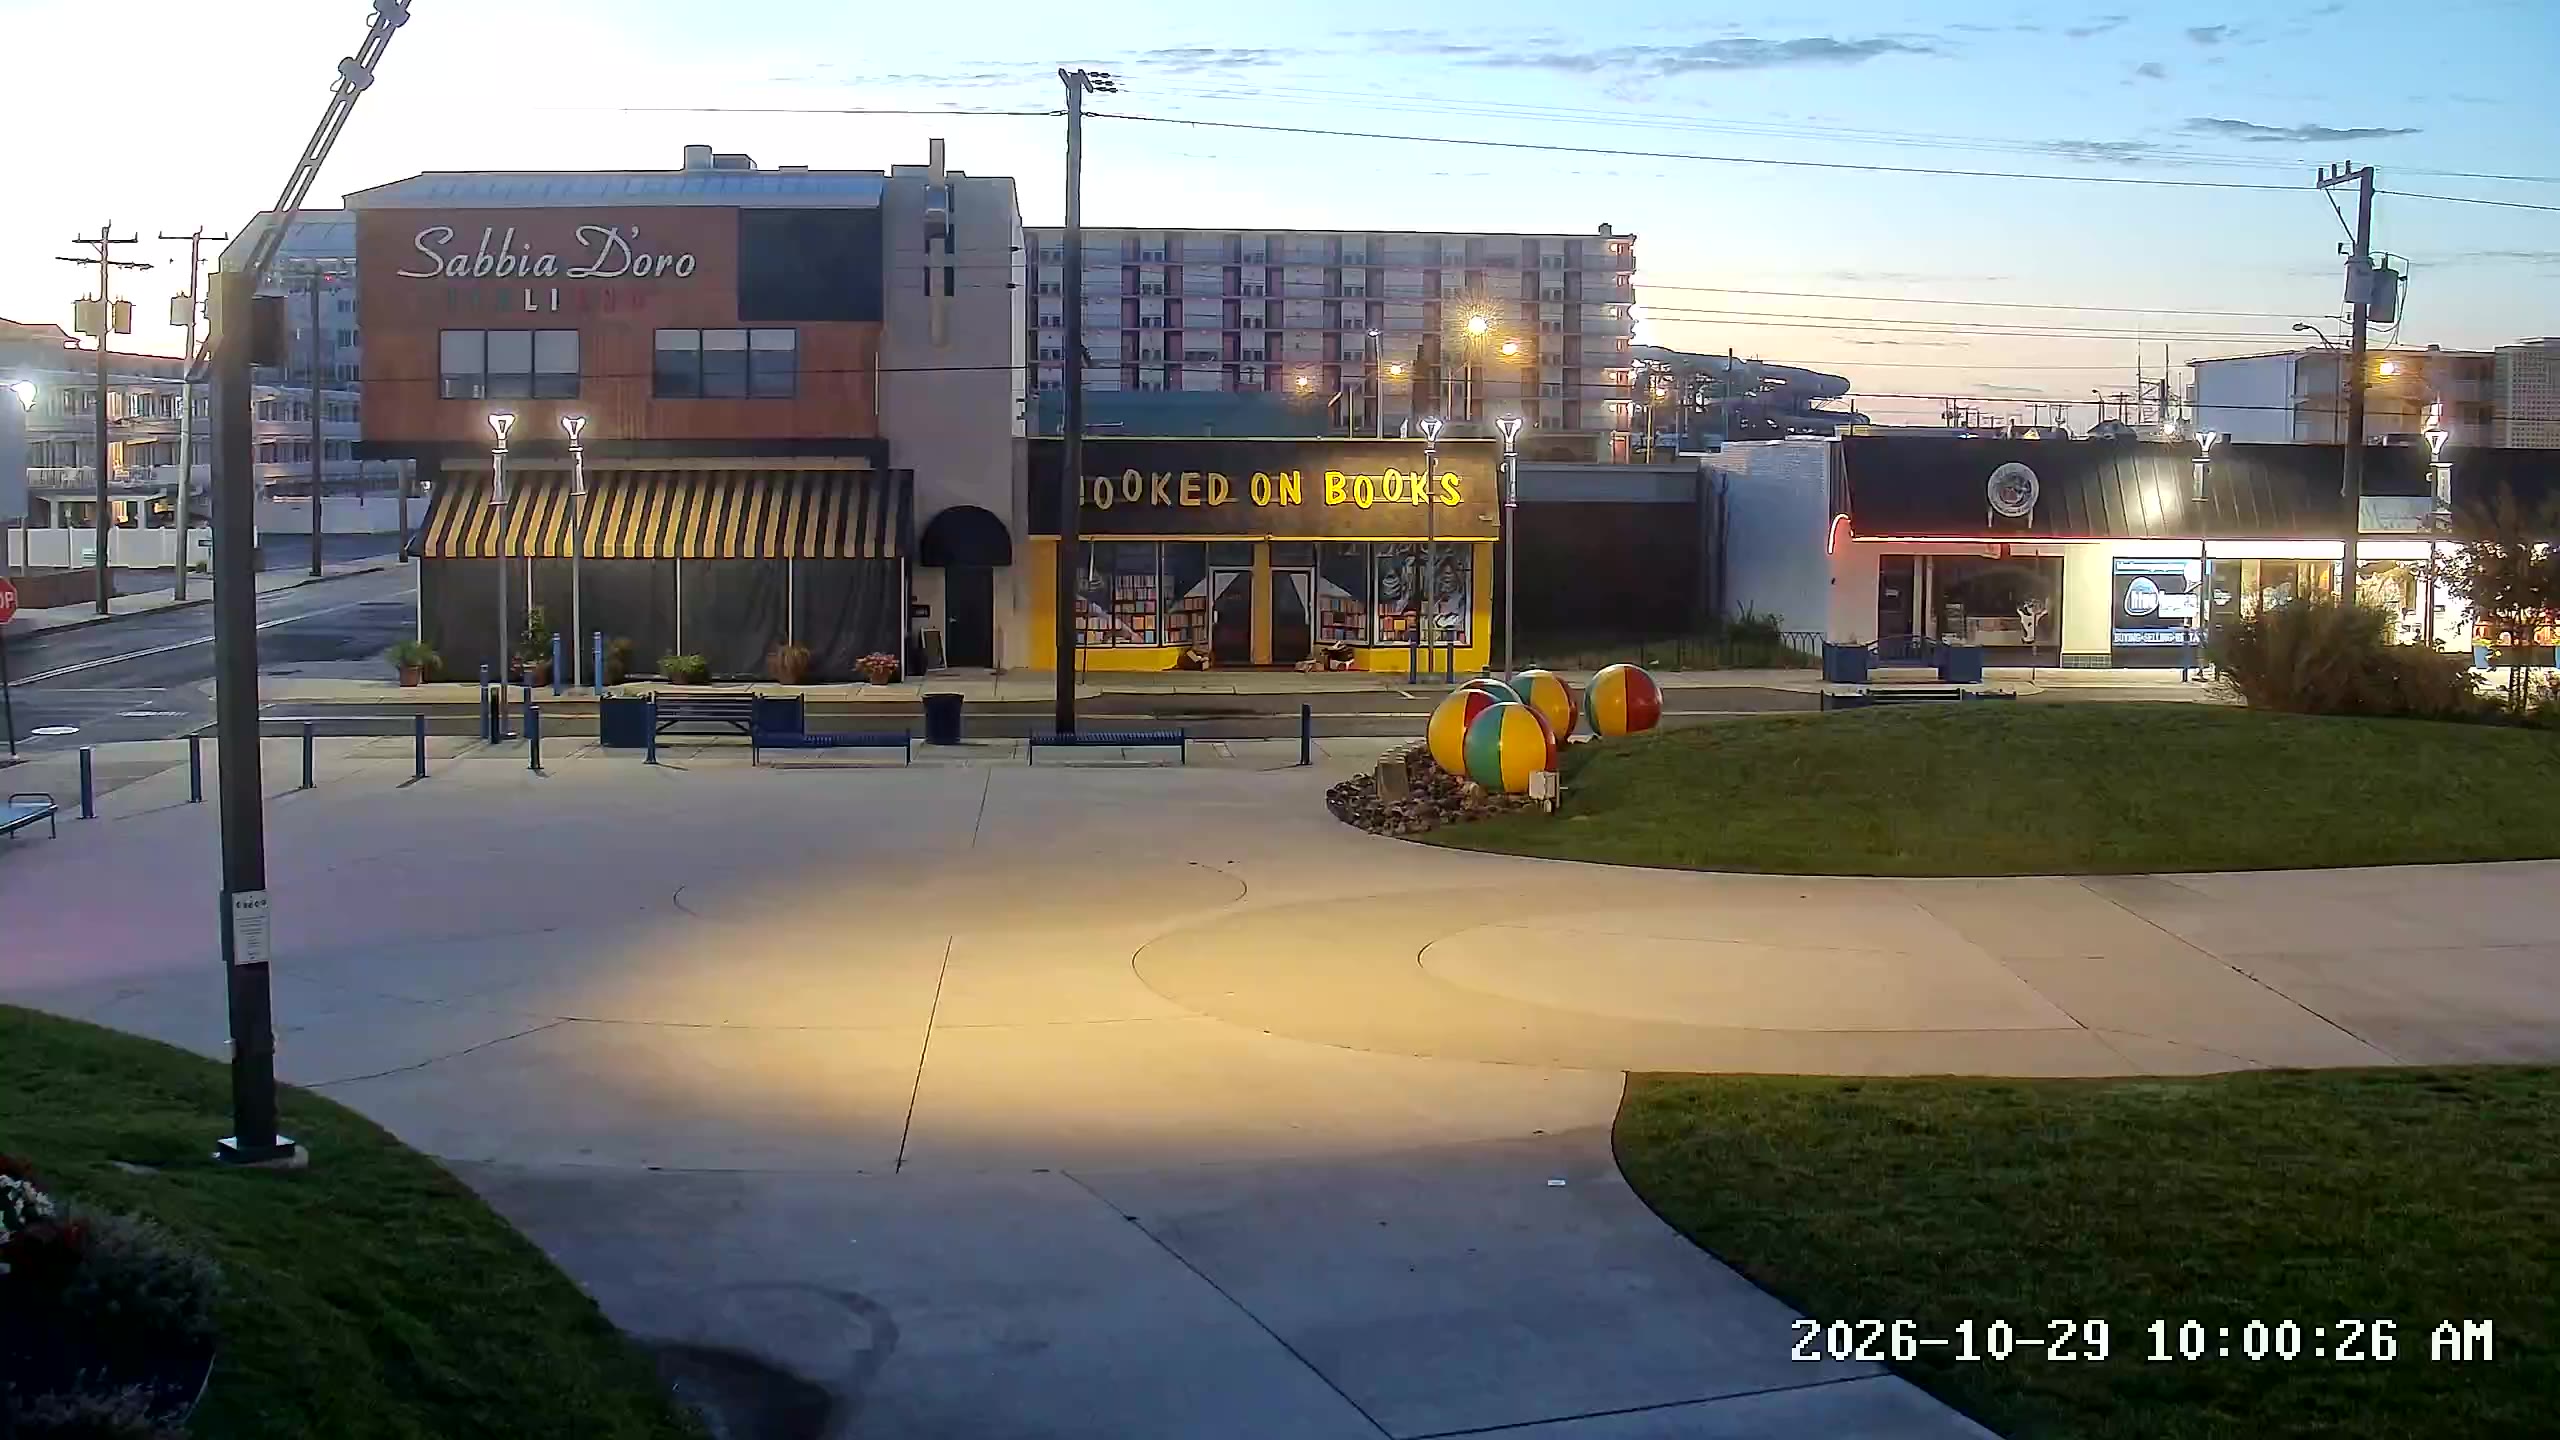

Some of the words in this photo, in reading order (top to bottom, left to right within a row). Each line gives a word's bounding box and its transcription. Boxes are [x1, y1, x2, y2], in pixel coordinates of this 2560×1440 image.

[397, 226, 558, 278] Sabbia
[566, 225, 696, 278] D'oro
[1250, 470, 1302, 507] ON
[1324, 467, 1461, 509] BOOKS
